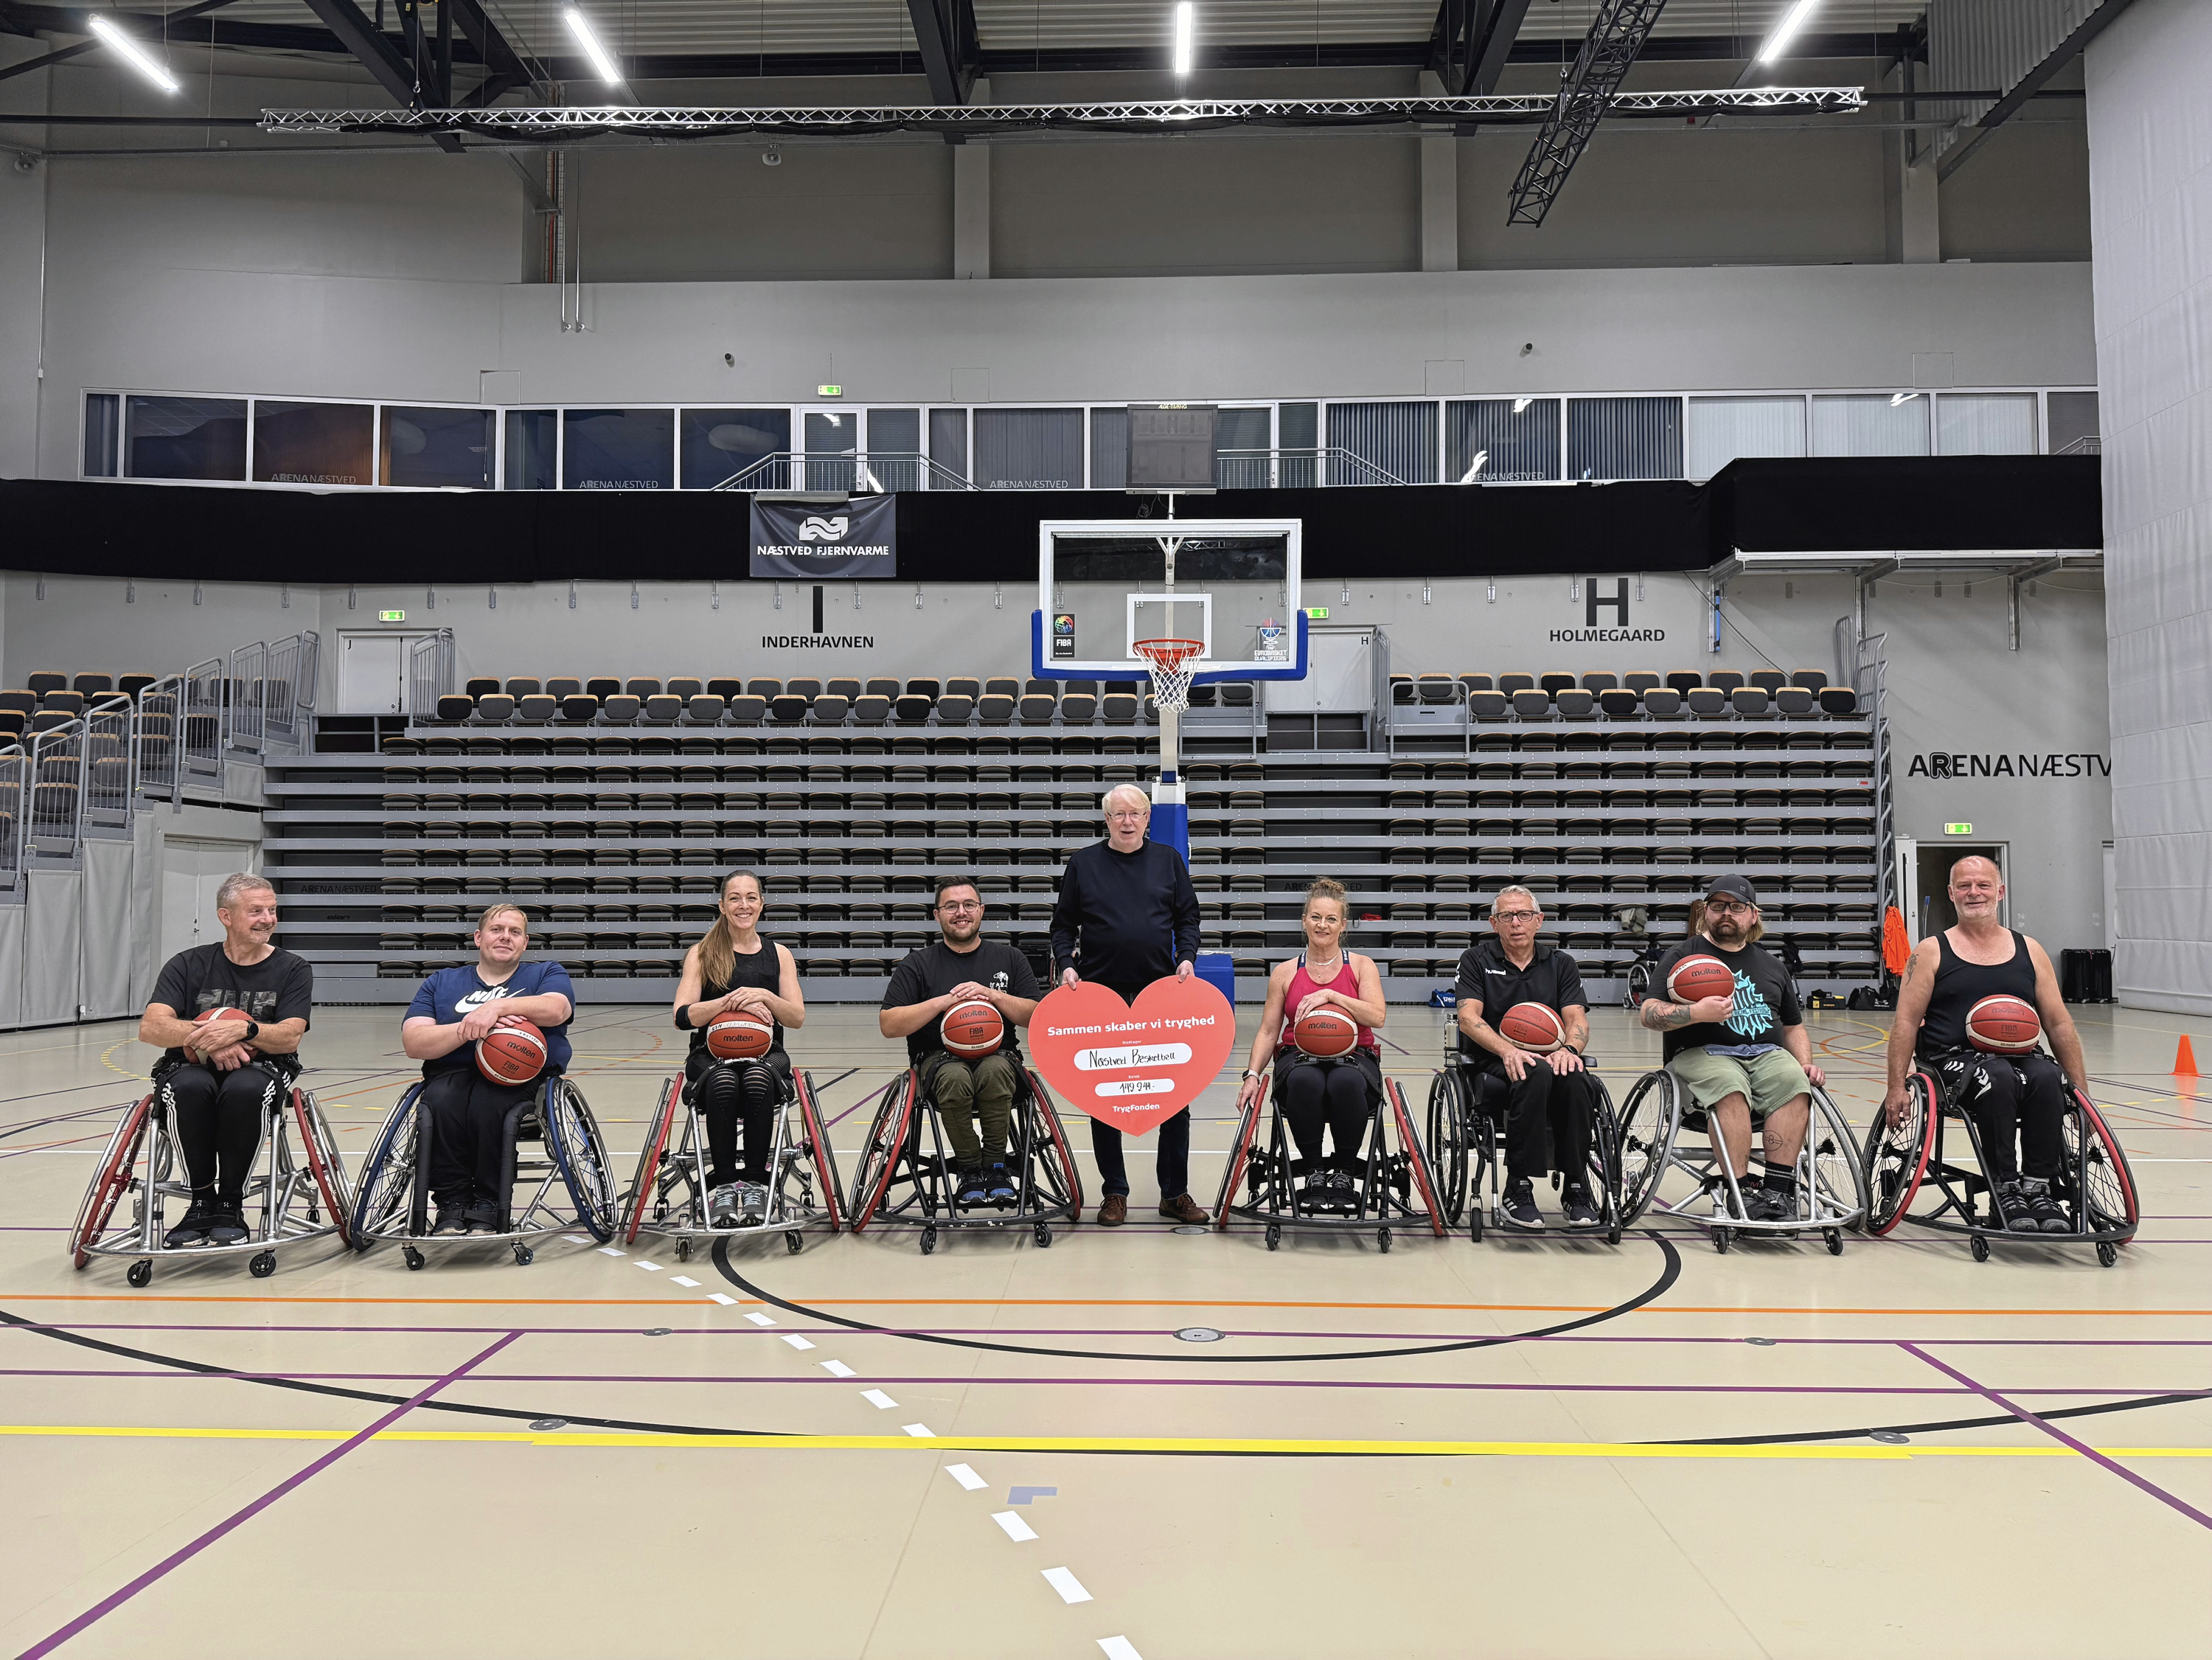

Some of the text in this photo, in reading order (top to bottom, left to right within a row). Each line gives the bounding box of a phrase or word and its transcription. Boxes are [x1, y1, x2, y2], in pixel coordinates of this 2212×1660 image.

[757, 546, 889, 555] NÆSTVED FJERNVARME
[1586, 577, 1629, 627] H
[1361, 636, 1368, 645] H
[1550, 629, 1666, 642] HOLMEGAARD
[762, 636, 874, 648] INDERHAVNEN
[1057, 639, 1072, 647] FIBA
[1691, 968, 1722, 977] molten
[959, 1010, 988, 1019] molten
[970, 1027, 984, 1035] FIBA
[1047, 1015, 1215, 1036] Sammen skaber vi tryghed
[507, 1041, 536, 1059] molten
[504, 1060, 520, 1072] FIBA
[1112, 1103, 1160, 1114] TrygFonden
